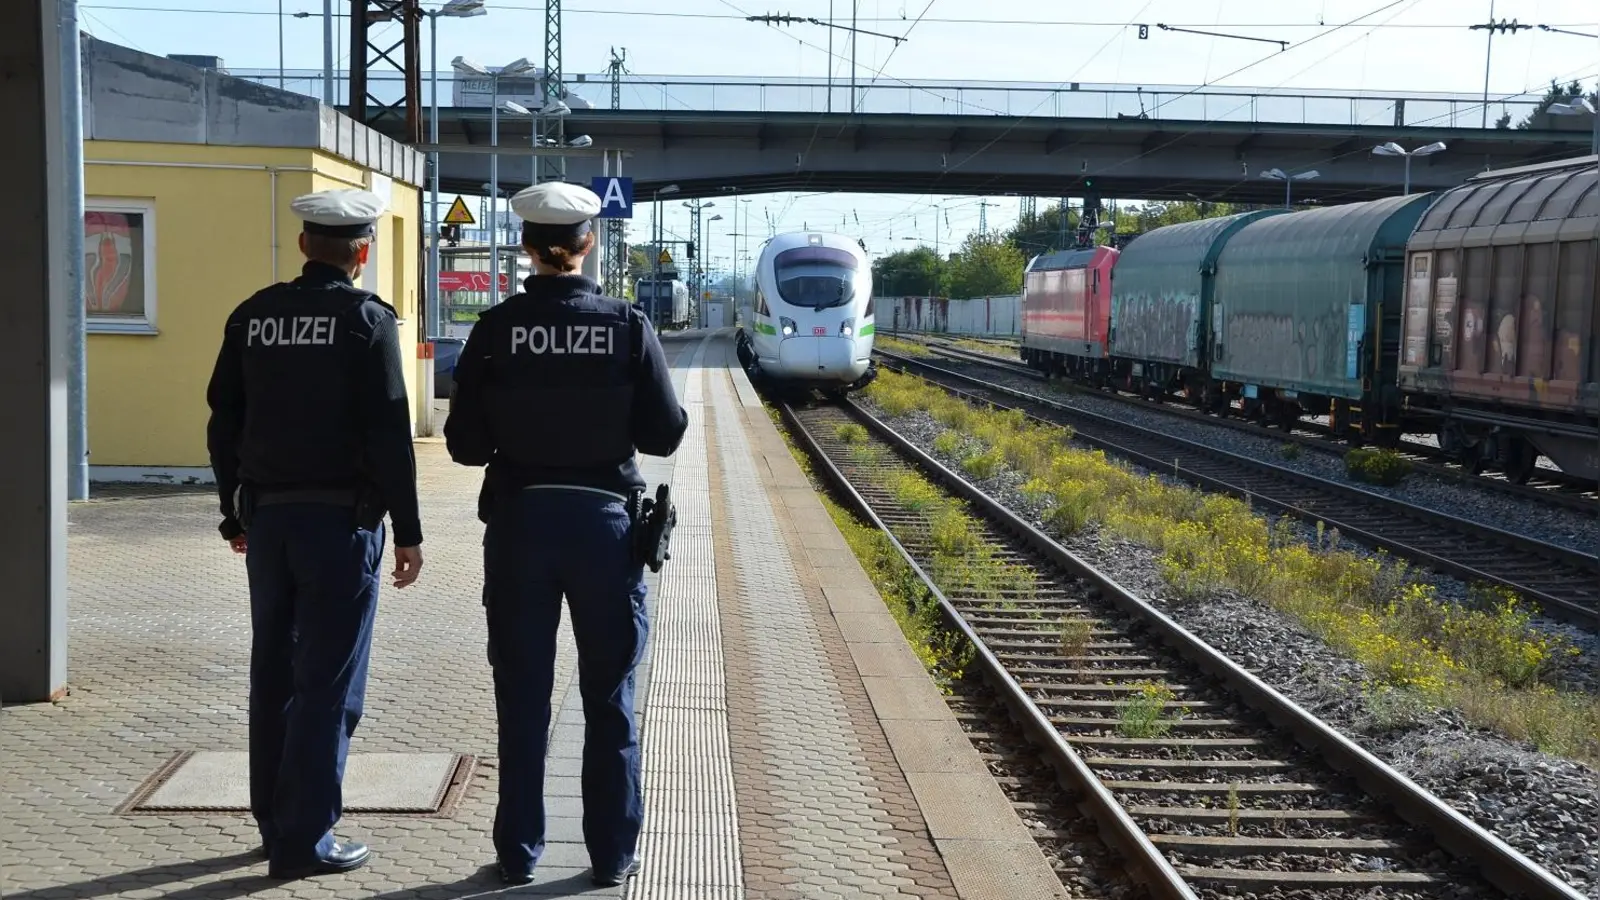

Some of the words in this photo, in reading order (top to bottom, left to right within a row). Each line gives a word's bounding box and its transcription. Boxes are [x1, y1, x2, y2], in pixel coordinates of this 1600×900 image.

[1140, 26, 1147, 38] 3
[602, 178, 627, 208] A
[247, 317, 336, 346] POLIZEI
[511, 326, 614, 354] POLIZEI
[813, 327, 825, 335] DB
